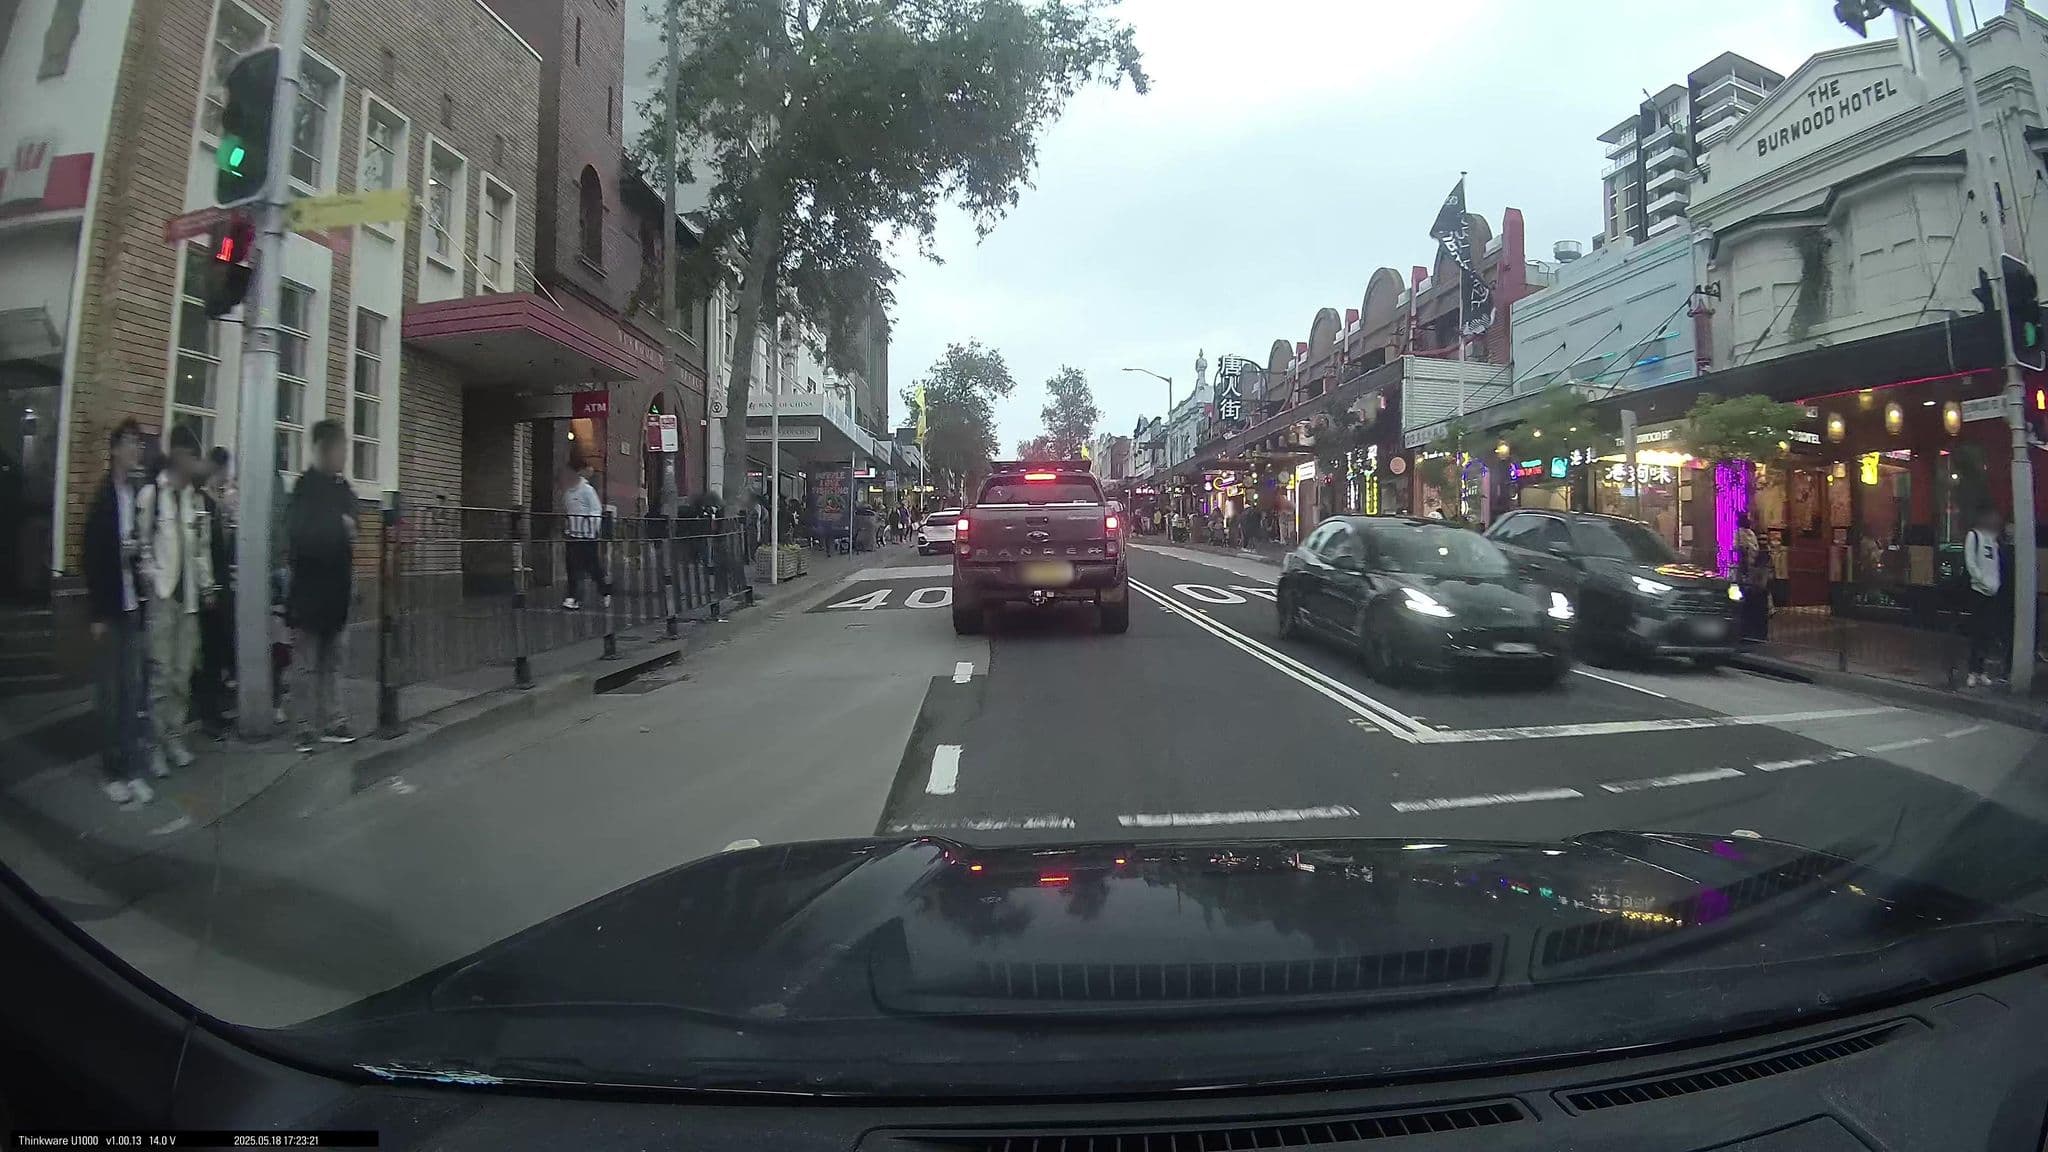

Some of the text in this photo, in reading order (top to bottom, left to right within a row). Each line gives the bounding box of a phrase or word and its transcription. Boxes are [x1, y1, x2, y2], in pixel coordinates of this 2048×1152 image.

[1807, 79, 1841, 107] THE
[1757, 78, 1897, 157] BURWOOD HOTEL
[1218, 354, 1242, 420] 唐人街
[583, 402, 607, 413] ATM
[975, 547, 1102, 558] RANGER
[827, 587, 953, 610] 40
